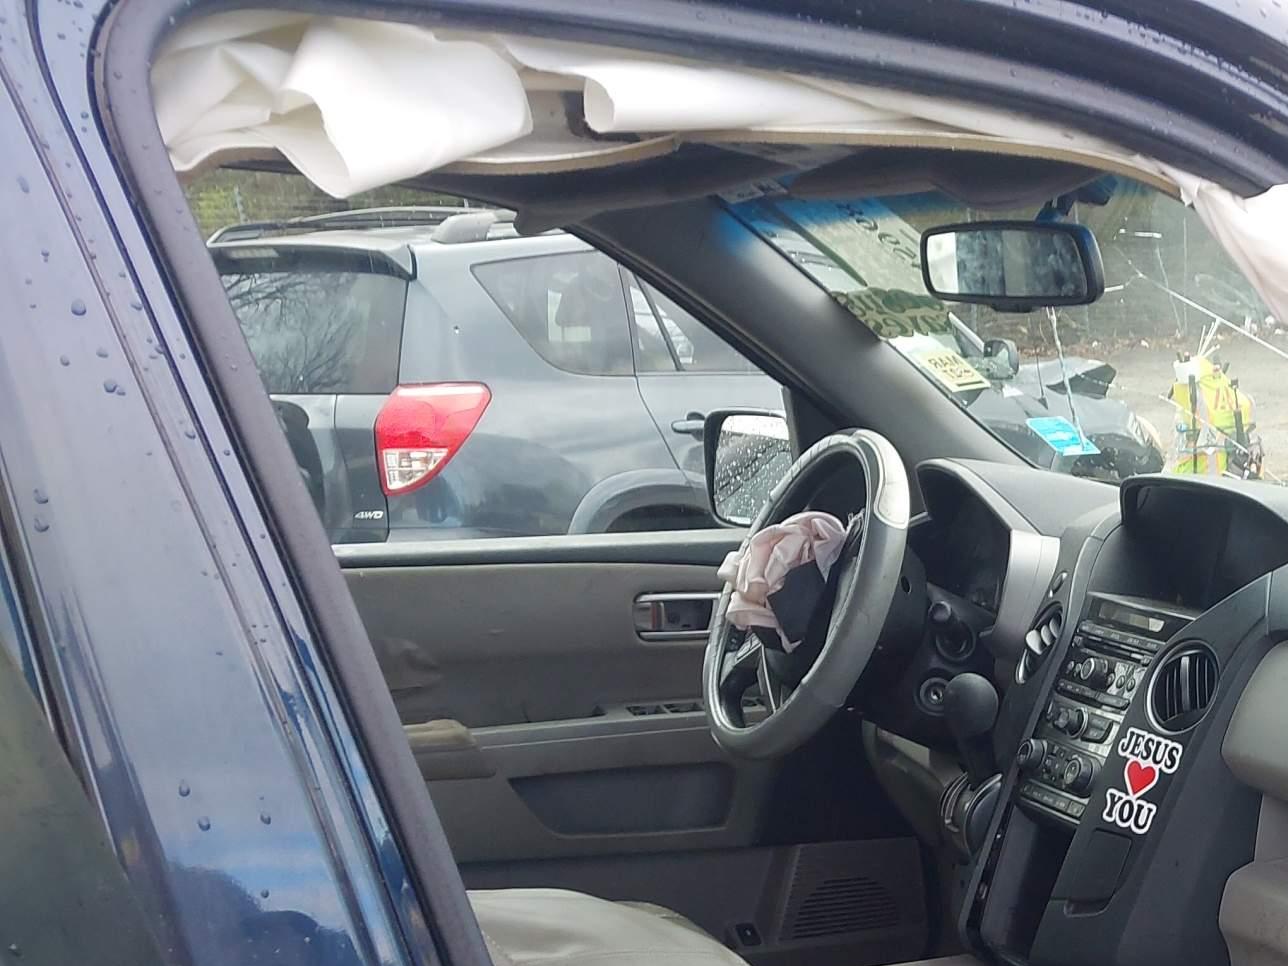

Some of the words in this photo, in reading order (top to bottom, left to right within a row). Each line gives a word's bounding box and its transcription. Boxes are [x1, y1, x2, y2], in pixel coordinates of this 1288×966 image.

[354, 510, 384, 520] 4WD
[1120, 730, 1180, 770] JESUS
[1106, 792, 1153, 829] YOU
